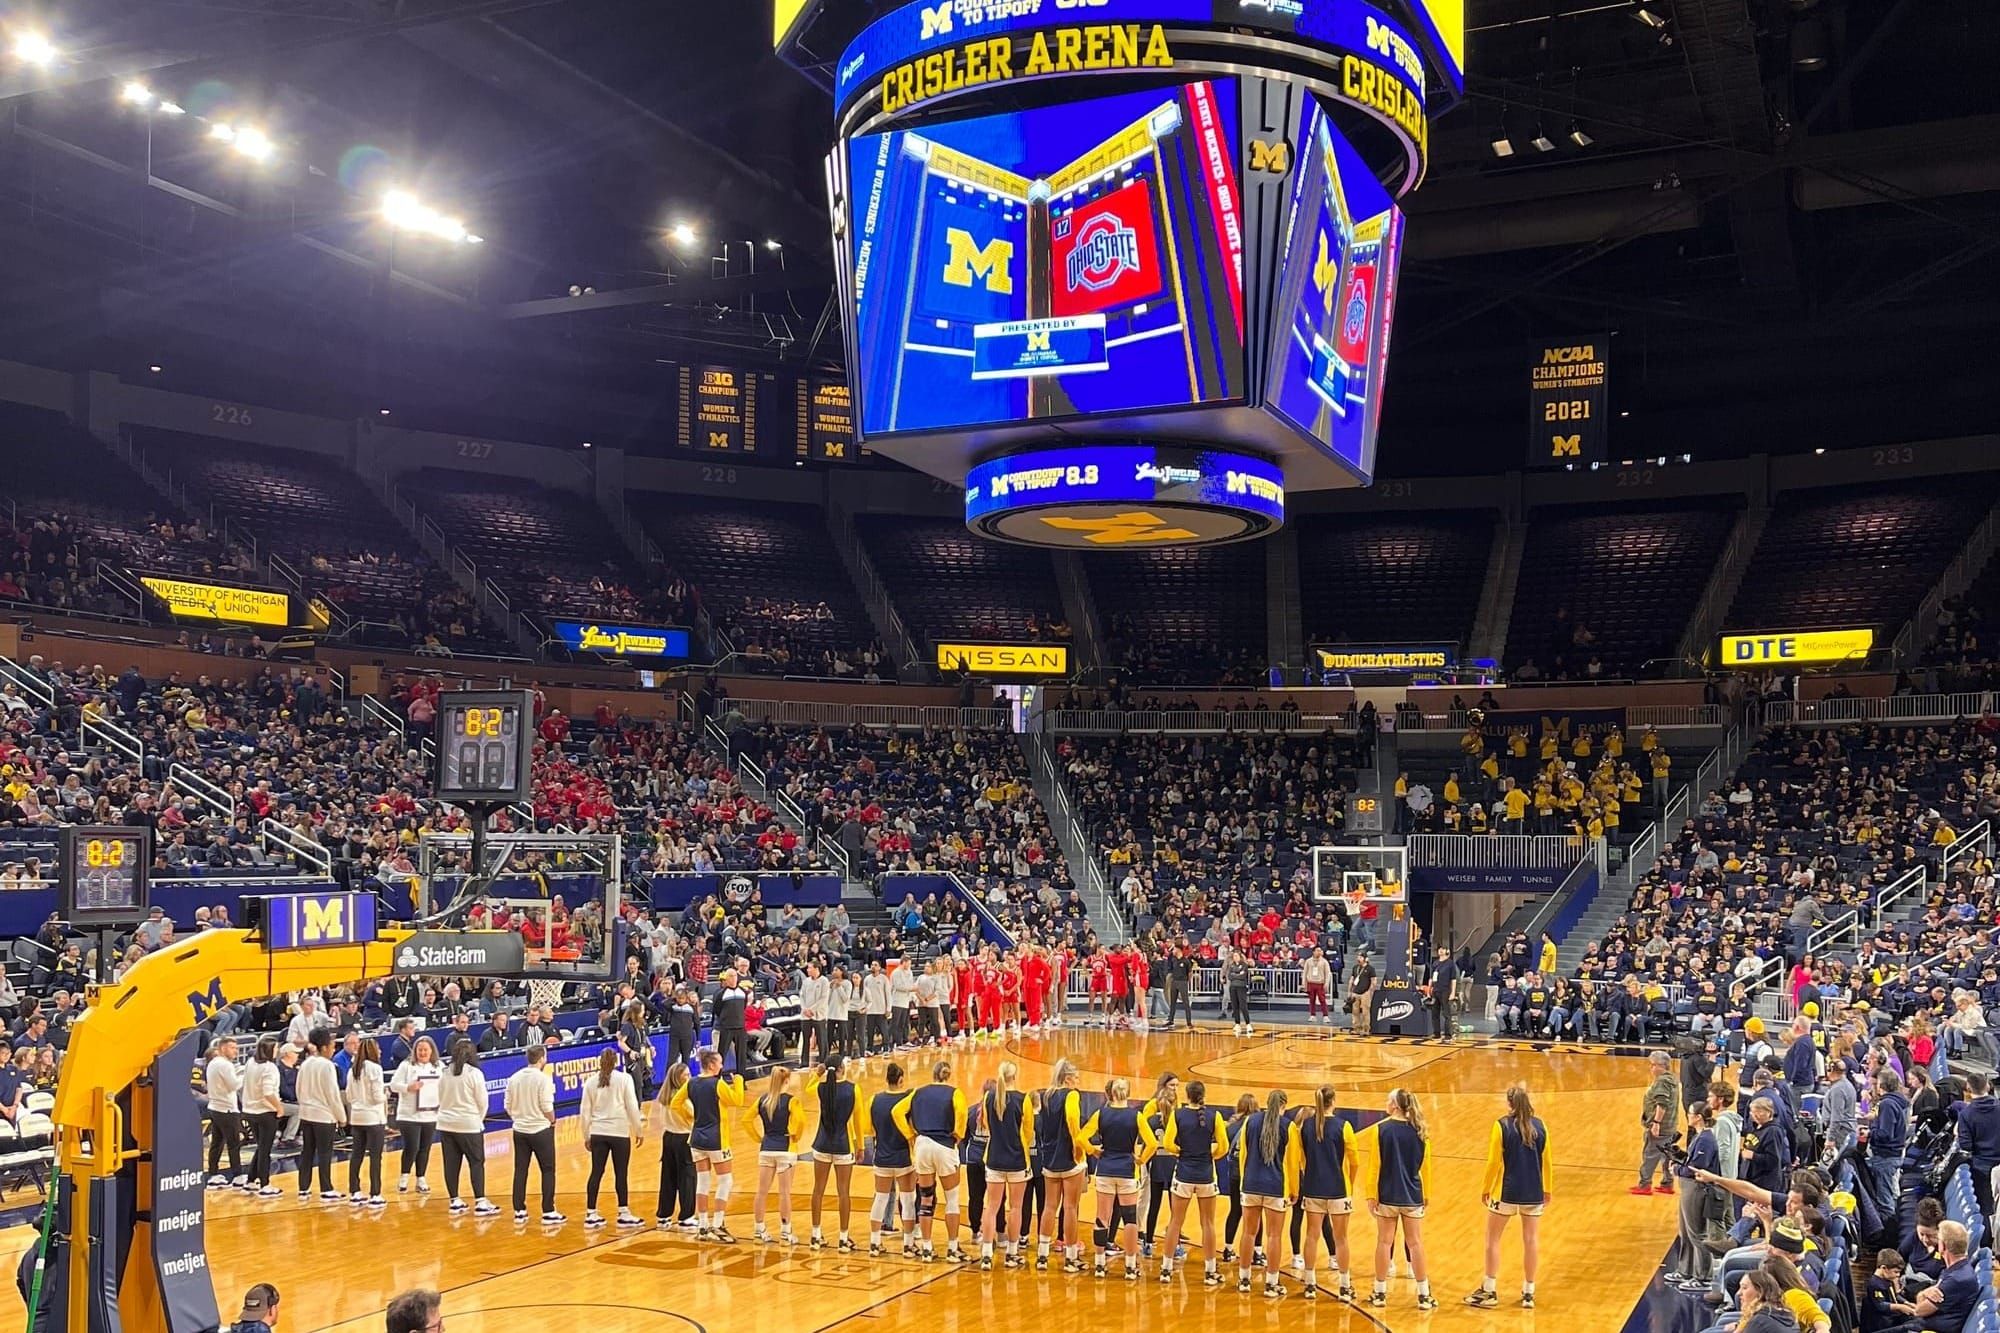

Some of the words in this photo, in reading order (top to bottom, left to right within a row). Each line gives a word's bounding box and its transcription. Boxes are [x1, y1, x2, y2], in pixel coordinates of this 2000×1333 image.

[920, 2, 952, 40] M
[962, 11, 983, 26] TO
[986, 0, 1042, 21] TIPOFF
[1366, 16, 1390, 57] M
[882, 37, 1012, 113] CRISLER
[1024, 24, 1174, 76] ARENA
[1343, 54, 1422, 142] CRISLER
[1251, 139, 1287, 171] M
[865, 169, 885, 235] WOLVERINES
[1055, 220, 1069, 236] 17
[855, 240, 872, 299] MICHIGAN
[943, 227, 1013, 295] M
[1002, 320, 1060, 333] PRESENTED
[1063, 319, 1077, 329] BY
[1026, 331, 1050, 351] M
[1542, 345, 1594, 364] NCAA
[1533, 362, 1604, 379] CHAMPIONS
[698, 385, 739, 396] CHAMPIONS
[1533, 380, 1562, 389] WOMEN'S
[1563, 376, 1604, 387] GYMNASTICS
[212, 404, 253, 426] 226
[698, 413, 740, 424] GYMNASTICS
[702, 403, 735, 414] WOMEN'S
[1545, 400, 1590, 421] 2021
[709, 431, 728, 449] M
[825, 442, 844, 457] M
[1552, 434, 1580, 457] M
[456, 440, 493, 461] 227
[1872, 447, 1914, 466] 233
[702, 466, 737, 484] 228
[1226, 470, 1247, 493] M
[1616, 469, 1655, 488] 232
[991, 474, 1009, 497] M
[214, 590, 229, 601] OF
[232, 593, 285, 607] MICHIGAN
[224, 603, 259, 614] UNION
[946, 651, 1058, 667] NISSAN
[1736, 638, 1796, 660] DTE
[1323, 653, 1446, 668] @UMICHATHLETICS
[1447, 875, 1476, 883] WEISER
[1485, 875, 1512, 883] FAMILY
[1522, 875, 1553, 884] TUNNEL
[303, 898, 343, 940] M
[87, 986, 99, 998] M
[1383, 980, 1409, 989] UMCU
[187, 975, 228, 1025] M
[562, 1075, 578, 1091] TO
[160, 1169, 203, 1191] meijer
[158, 1209, 202, 1232] meijer
[163, 1252, 206, 1276] meijer
